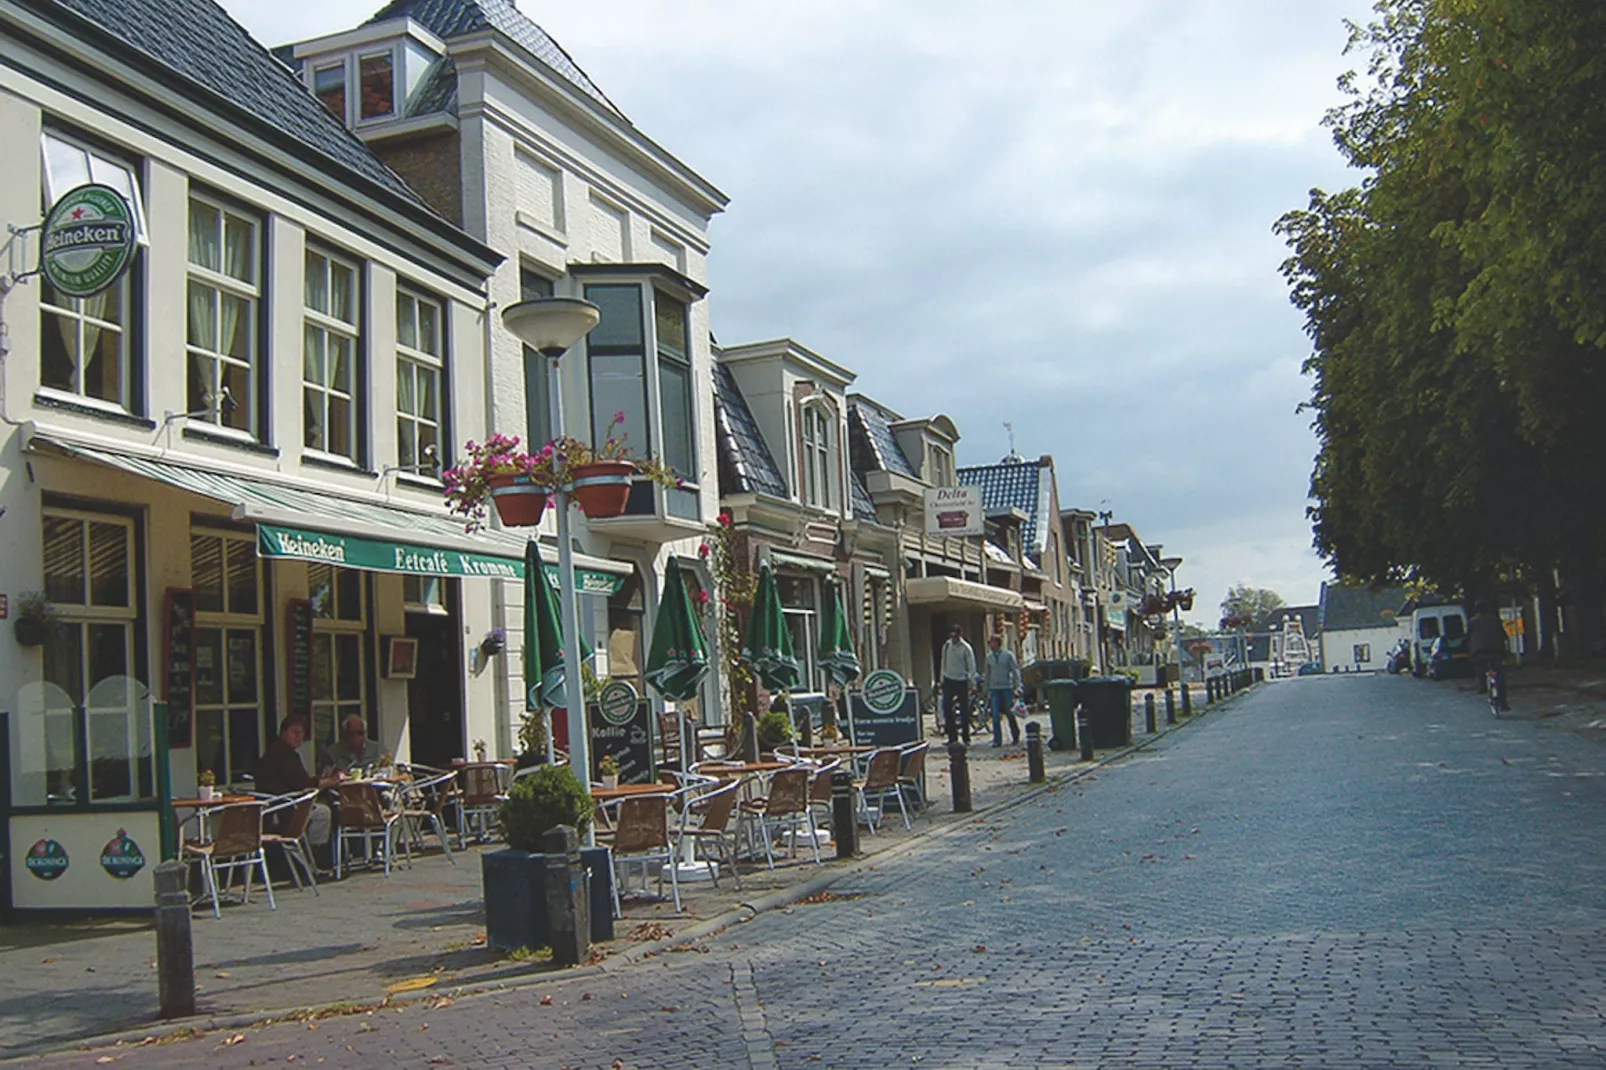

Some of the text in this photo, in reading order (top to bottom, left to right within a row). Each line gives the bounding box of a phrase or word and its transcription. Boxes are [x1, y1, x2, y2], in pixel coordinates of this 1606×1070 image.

[937, 489, 968, 500] Delta
[276, 532, 345, 562] Heineken
[394, 547, 449, 573] Eetcafé
[592, 726, 627, 739] Koffie
